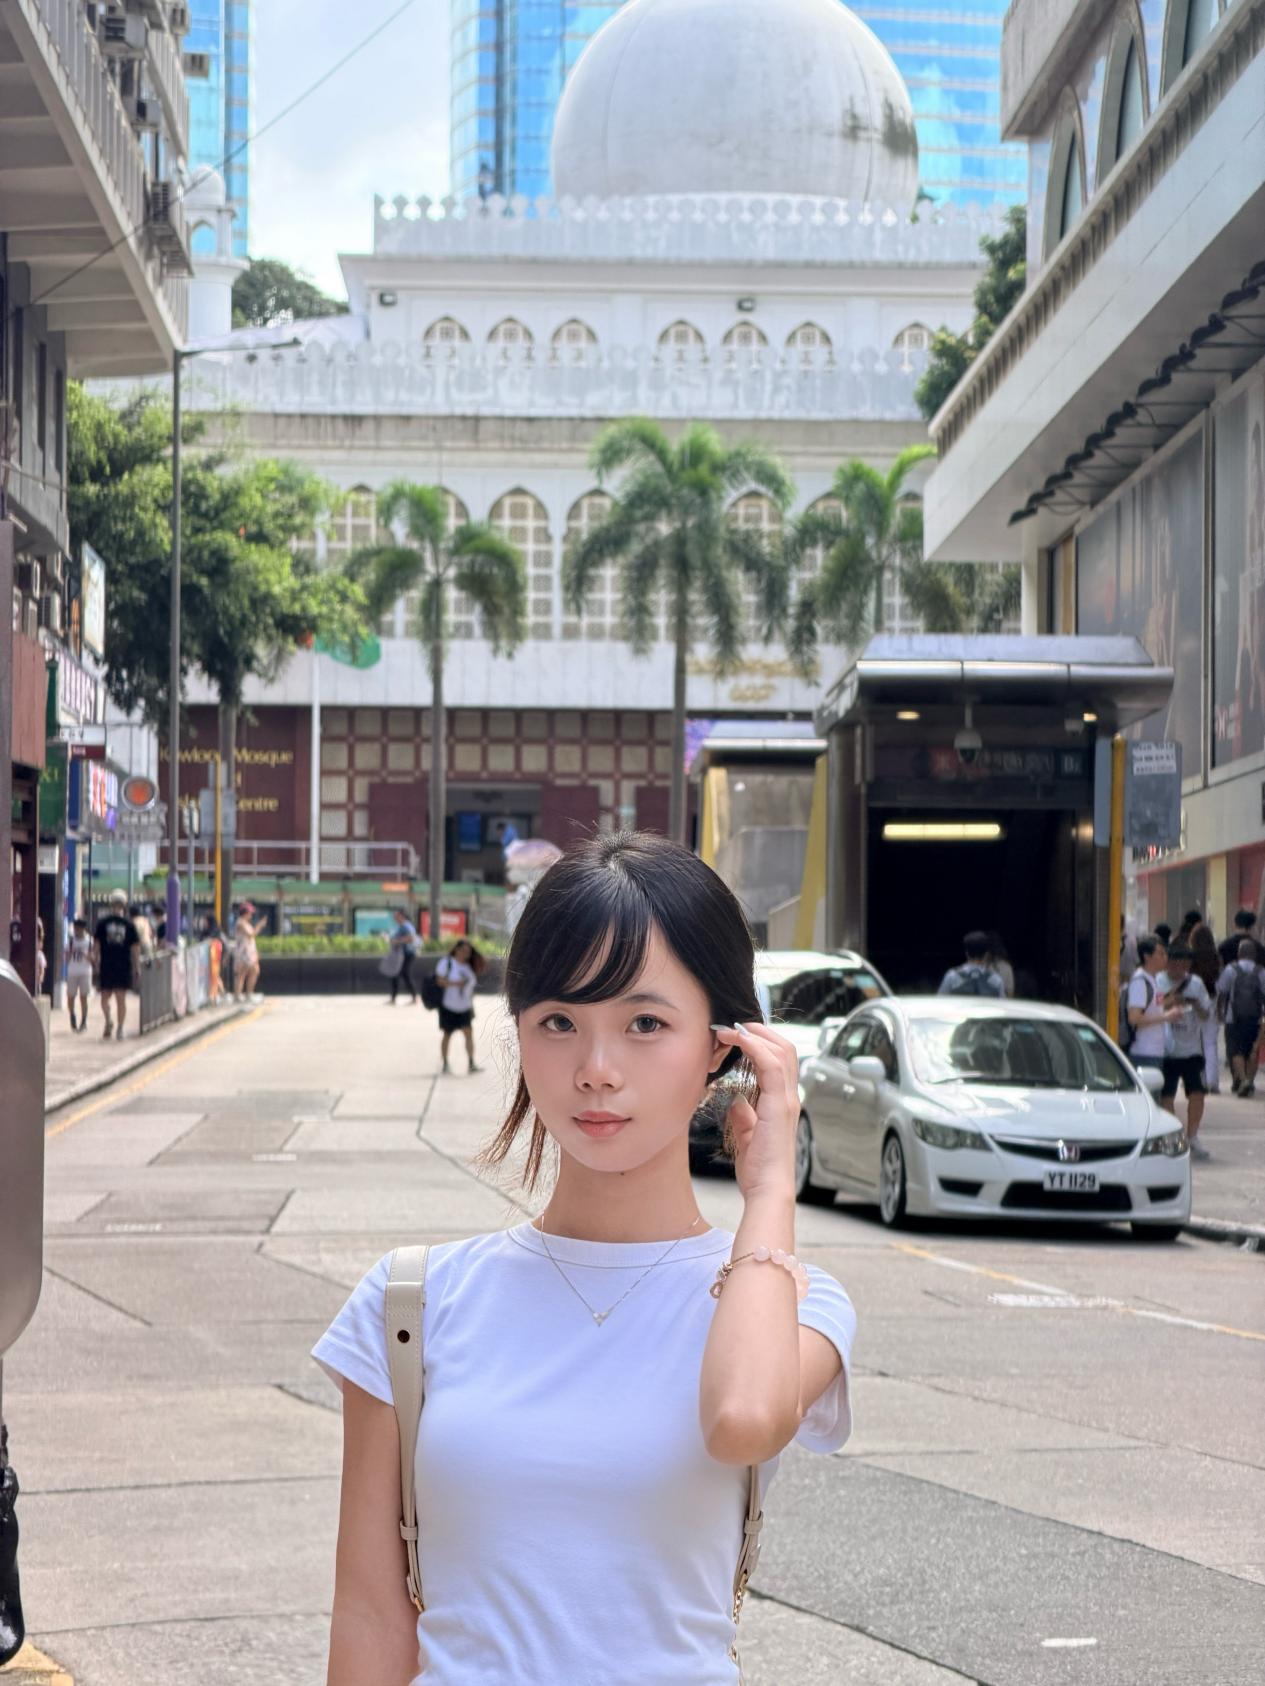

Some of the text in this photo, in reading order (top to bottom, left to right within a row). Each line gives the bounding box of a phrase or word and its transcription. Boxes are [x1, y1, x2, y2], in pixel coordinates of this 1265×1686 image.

[233, 747, 293, 768] Mosque
[1048, 1171, 1096, 1189] YT 1129
